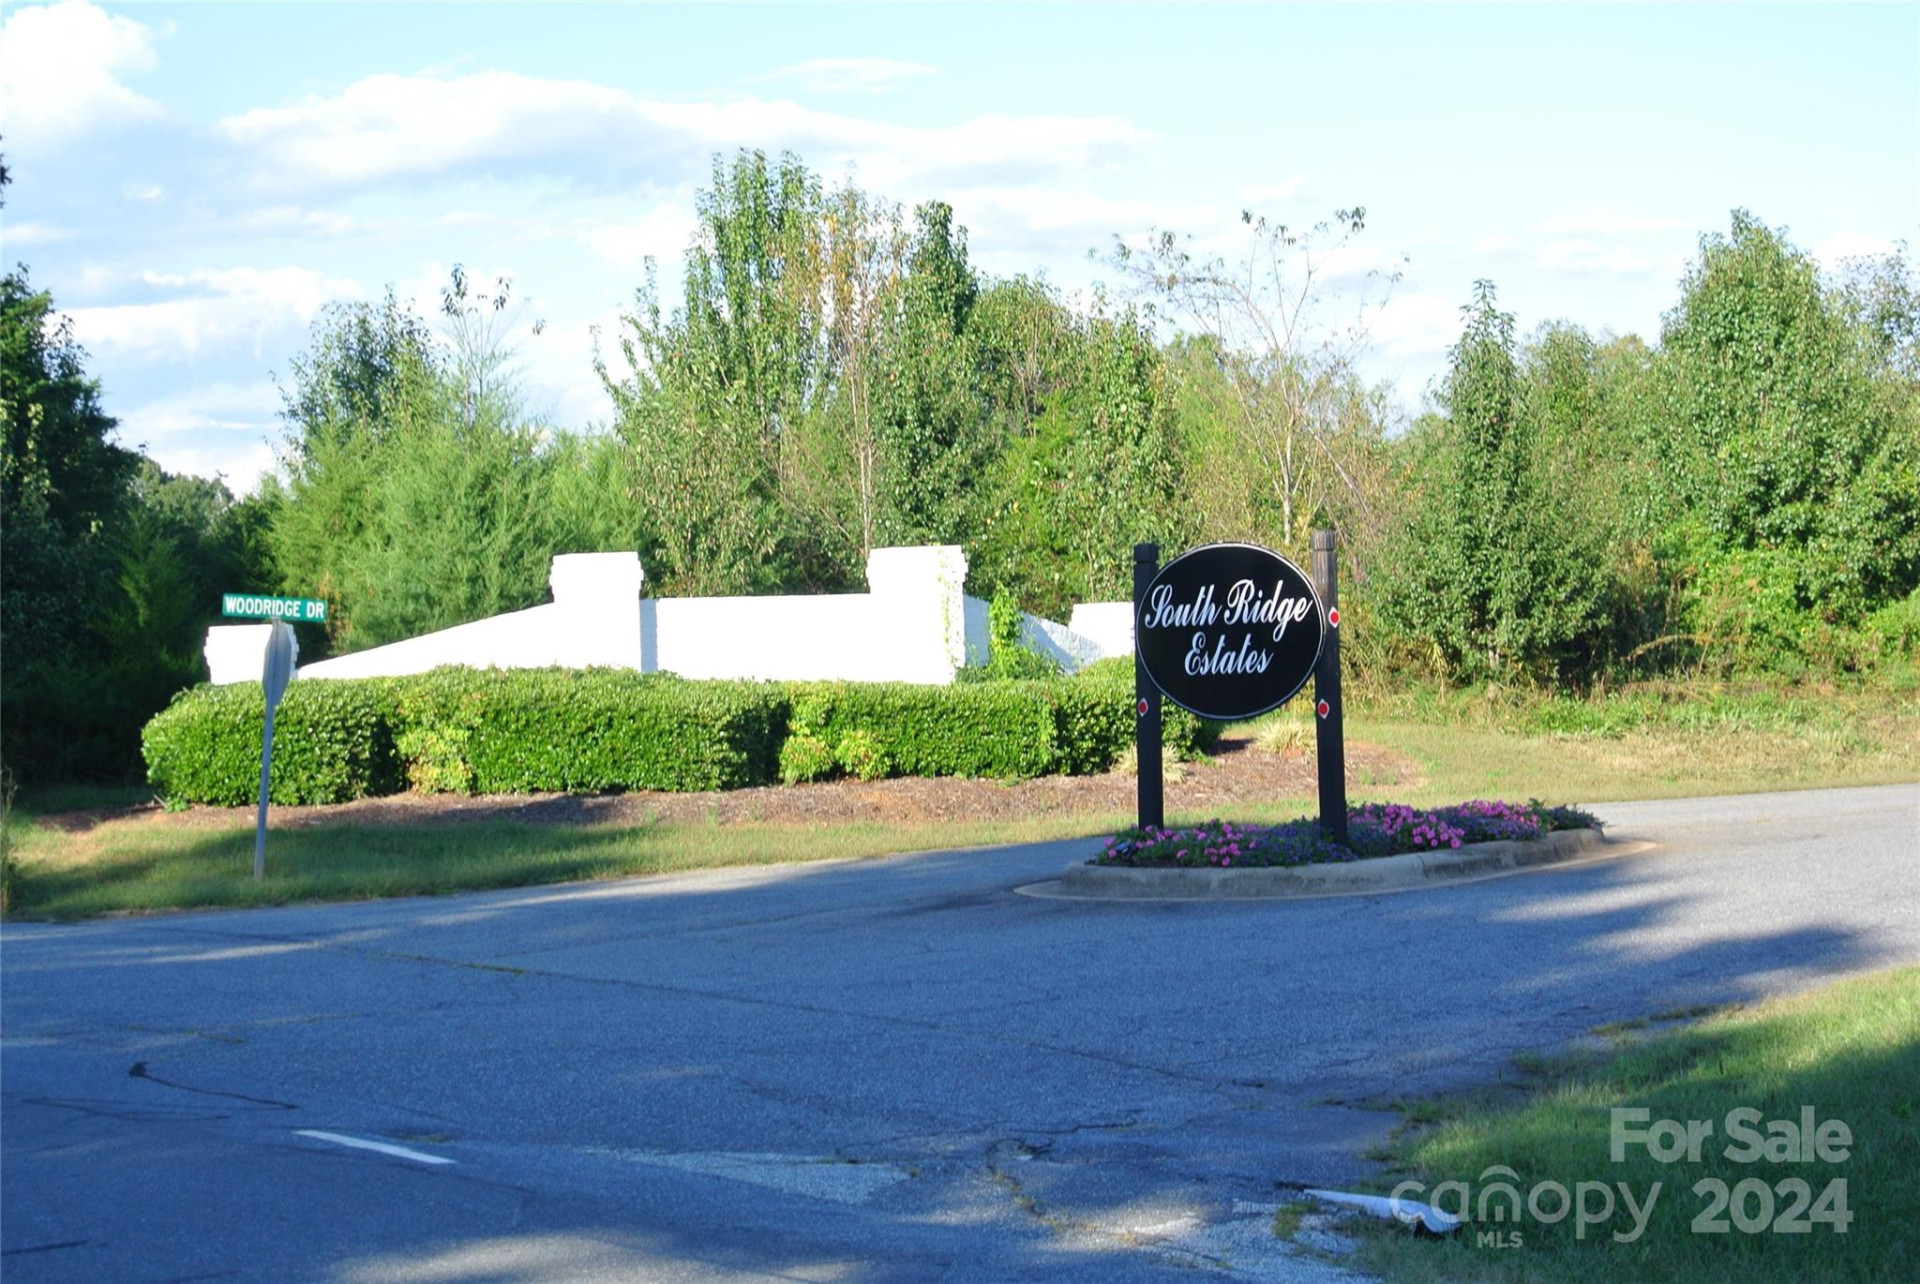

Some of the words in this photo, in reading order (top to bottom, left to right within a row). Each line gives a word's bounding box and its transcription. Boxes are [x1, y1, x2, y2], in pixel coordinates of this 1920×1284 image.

[225, 596, 301, 617] WOODRIDGE
[306, 601, 324, 619] DR
[1145, 584, 1222, 629] South
[1224, 579, 1313, 642] Ridge
[1184, 631, 1274, 676] Estates
